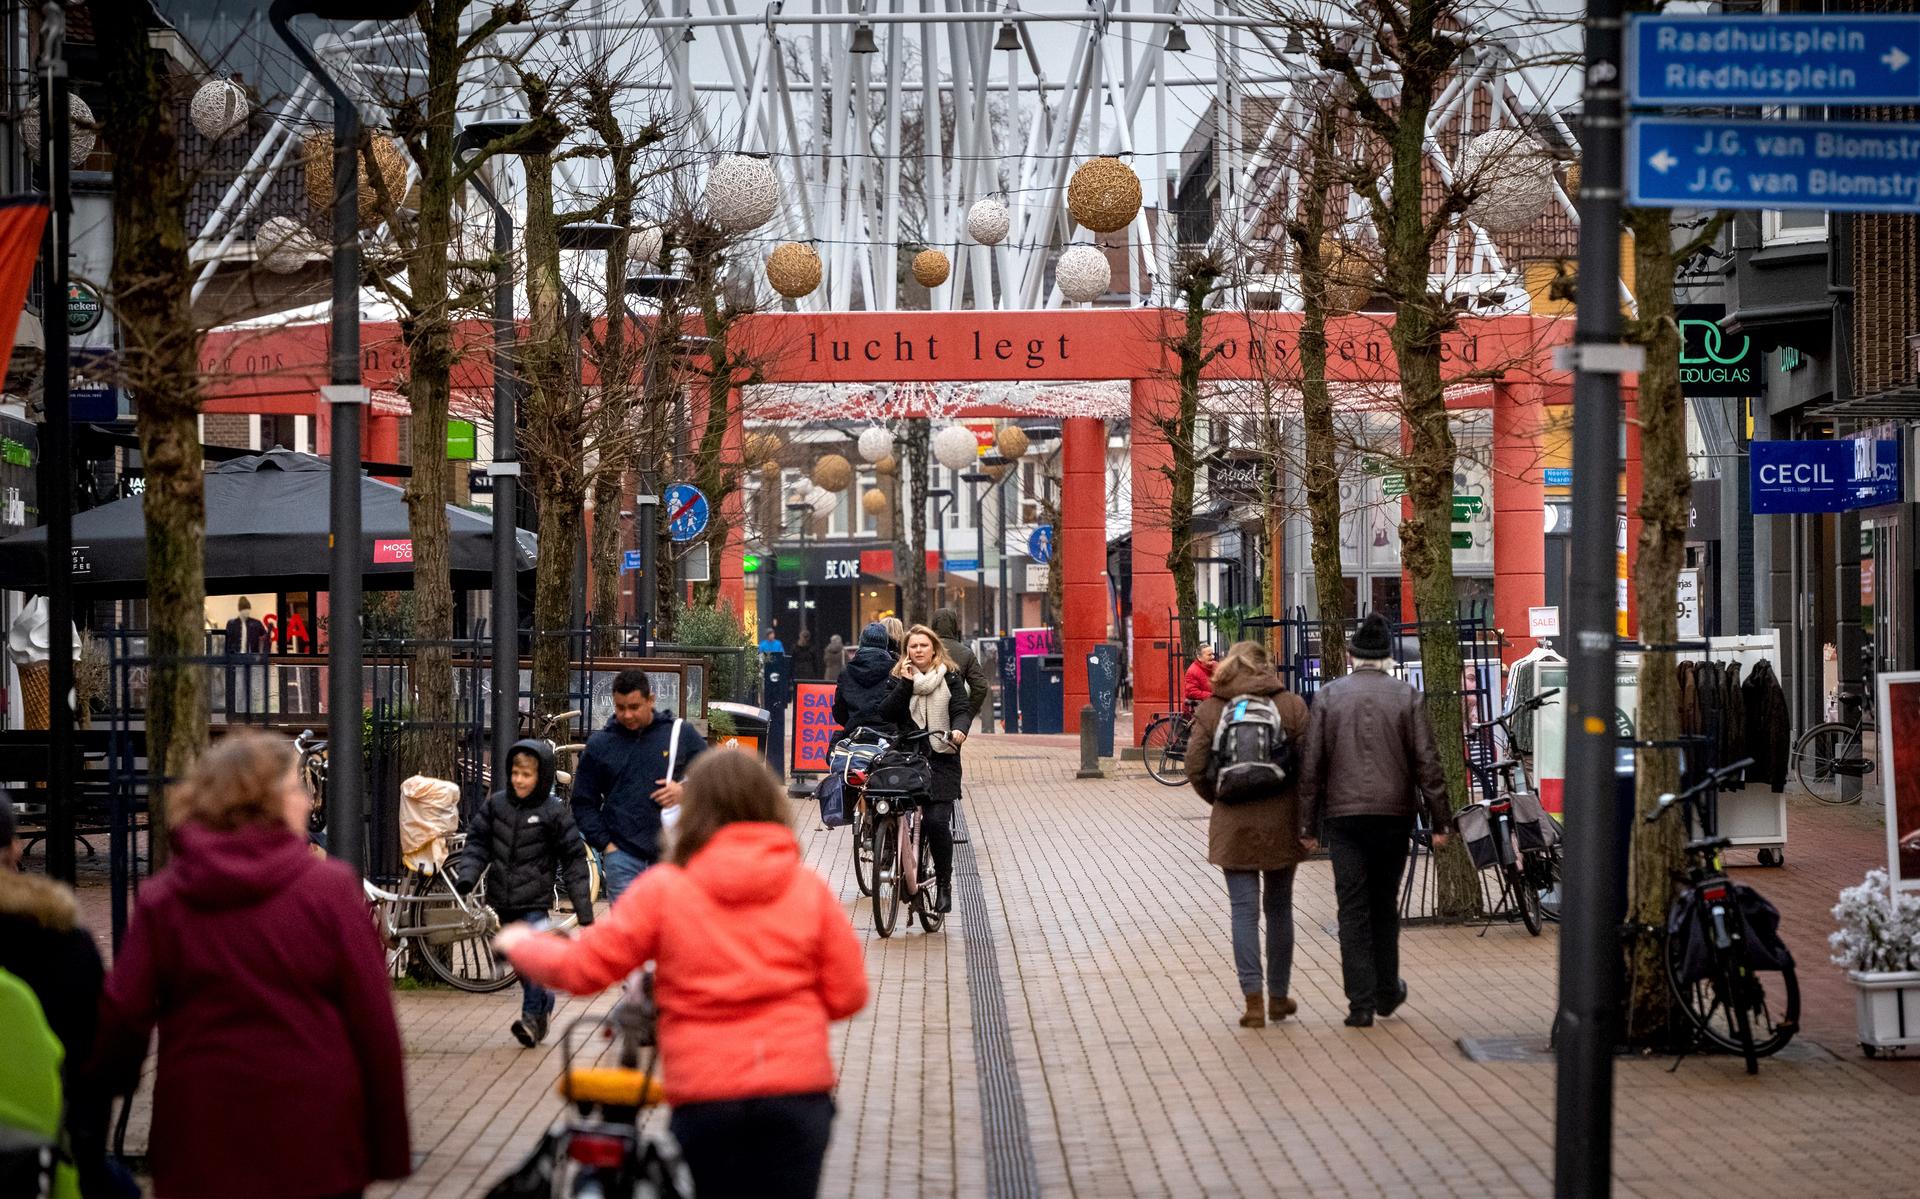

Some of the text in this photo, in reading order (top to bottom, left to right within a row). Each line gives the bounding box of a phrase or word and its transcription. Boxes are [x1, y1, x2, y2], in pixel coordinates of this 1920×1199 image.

[1657, 26, 1865, 55] Raadhuisplein
[1665, 63, 1856, 92] Riedhúsplein
[1755, 135, 1805, 156] van
[1749, 172, 1798, 194] van
[68, 302, 97, 311] neken
[808, 331, 939, 362] lucht
[972, 330, 1070, 369] legt
[1440, 334, 1478, 362] ed
[364, 349, 406, 370] na
[1680, 368, 1750, 383] DOUGLAS
[1759, 464, 1834, 484] CECIL
[129, 477, 146, 488] JAC
[383, 543, 412, 551] MOCC
[396, 550, 412, 559] D'O
[825, 560, 860, 579] BE ONE
[1532, 618, 1556, 627] SALE!
[803, 694, 834, 708] SAL
[802, 711, 838, 725] SAL
[802, 746, 826, 760] SA
